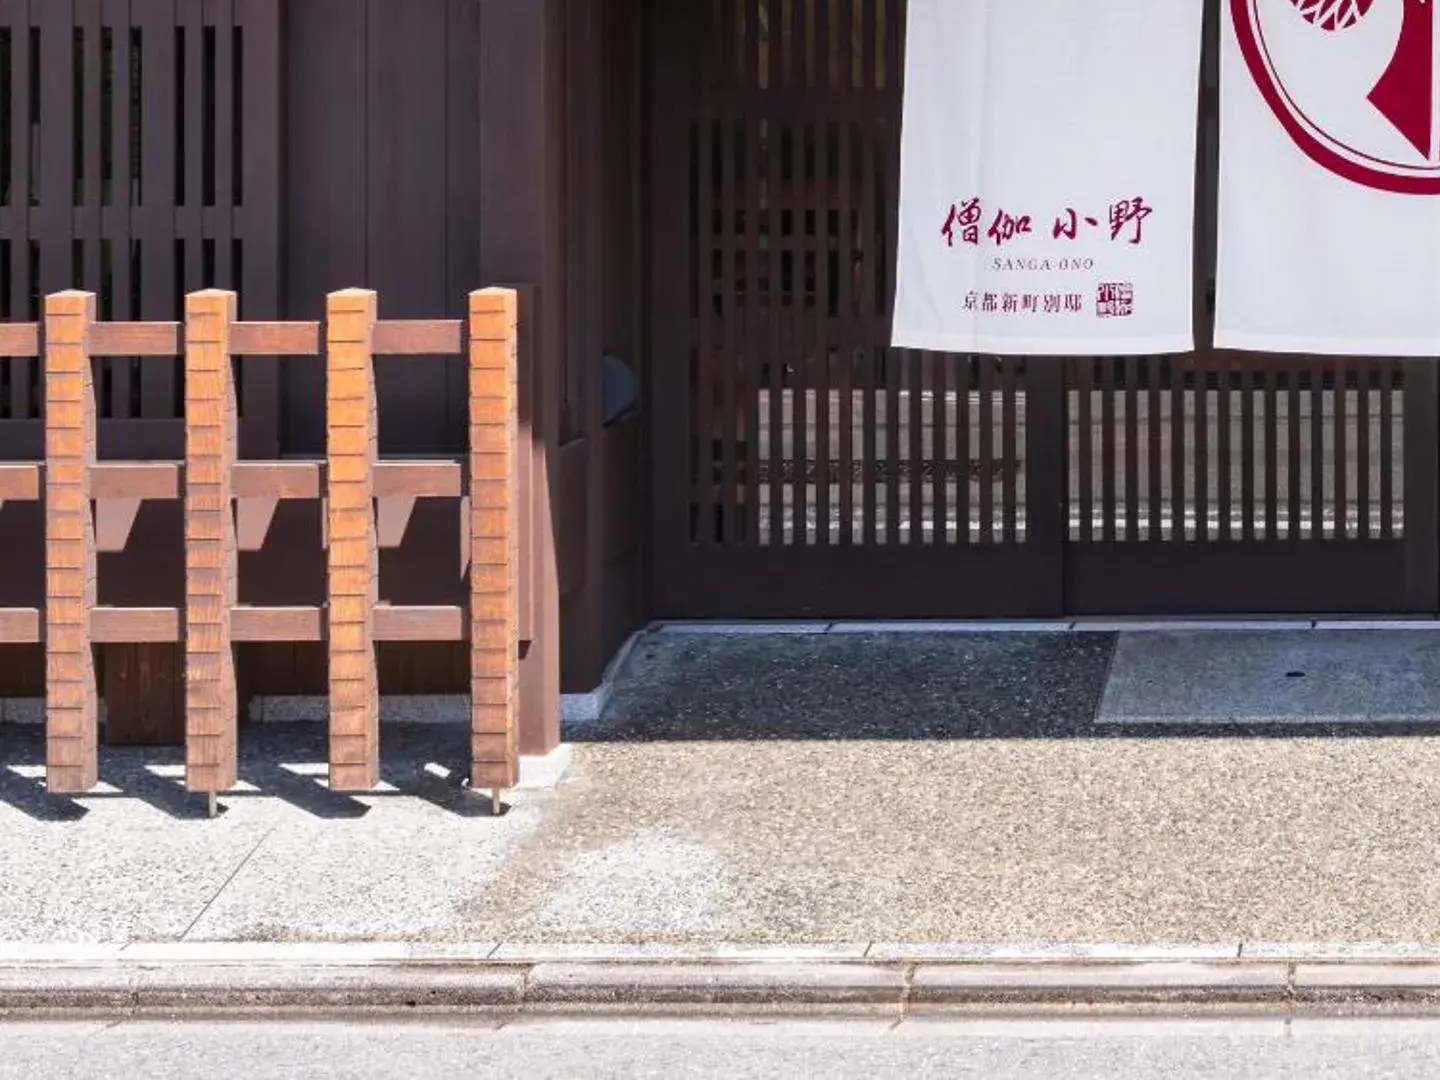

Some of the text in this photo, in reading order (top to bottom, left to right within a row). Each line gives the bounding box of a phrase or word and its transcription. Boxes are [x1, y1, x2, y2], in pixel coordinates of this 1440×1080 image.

[991, 257, 1052, 272] SANGA
[961, 290, 1083, 315] 京都新町別邸
